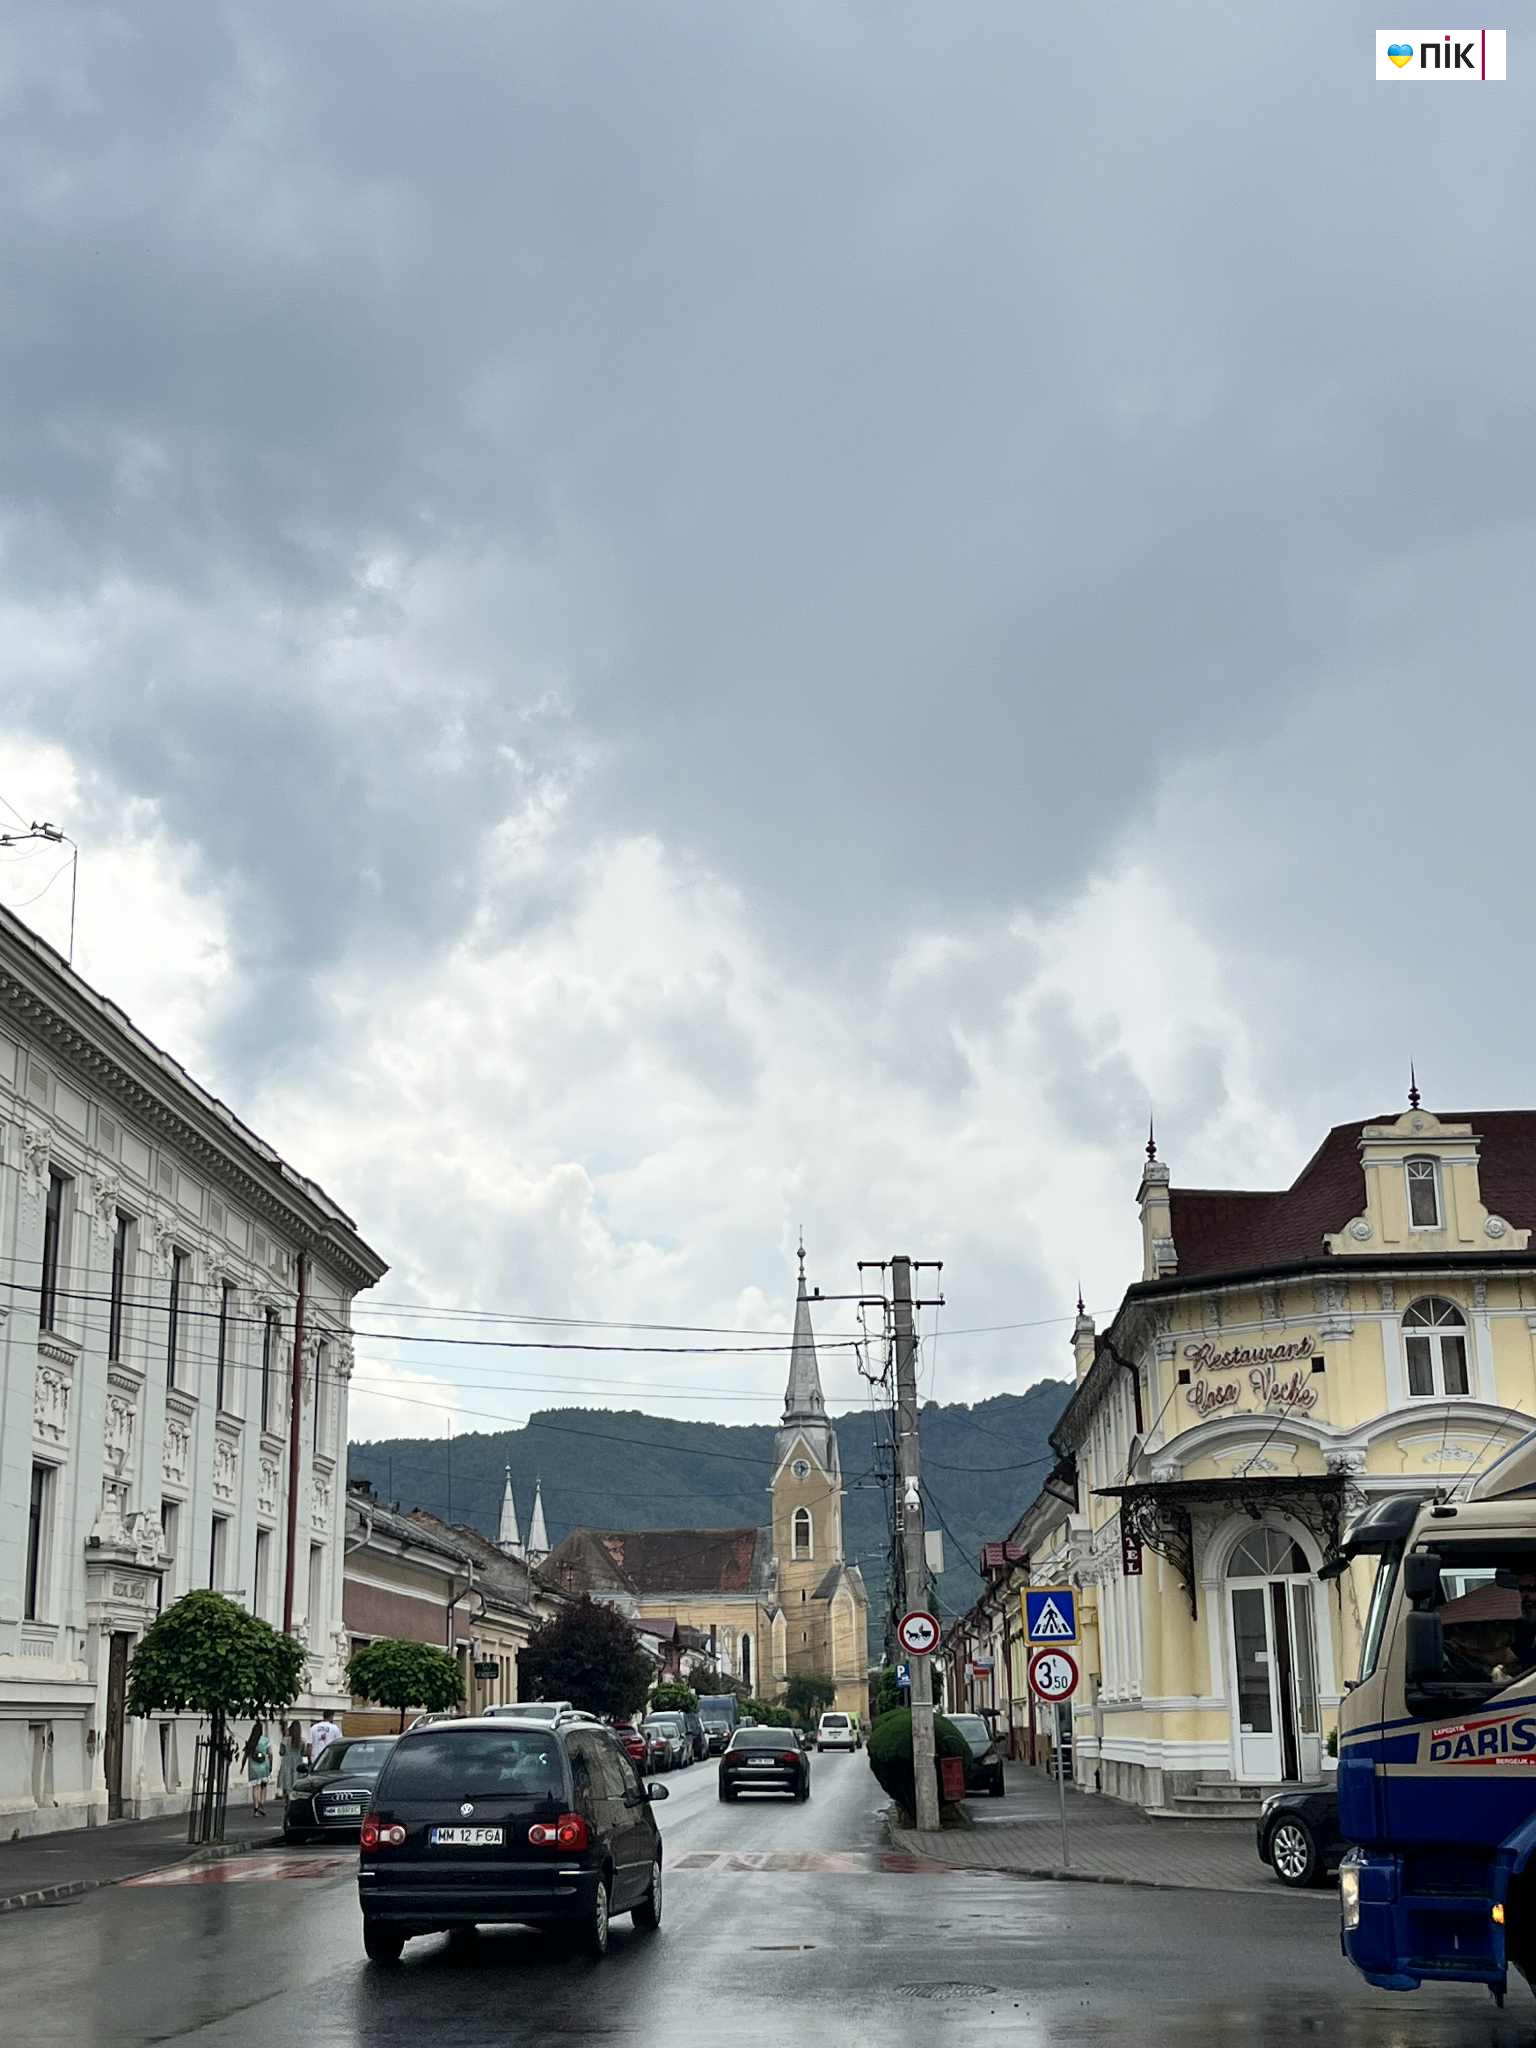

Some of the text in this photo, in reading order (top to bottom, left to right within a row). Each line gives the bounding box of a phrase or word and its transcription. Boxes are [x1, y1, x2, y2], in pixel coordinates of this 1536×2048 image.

[1184, 1336, 1315, 1374] Restaurant
[1186, 1377, 1240, 1417] Casa
[897, 1665, 905, 1678] P
[1430, 1718, 1536, 1762] DARIS
[438, 1829, 455, 1841] MM
[461, 1829, 472, 1841] 12
